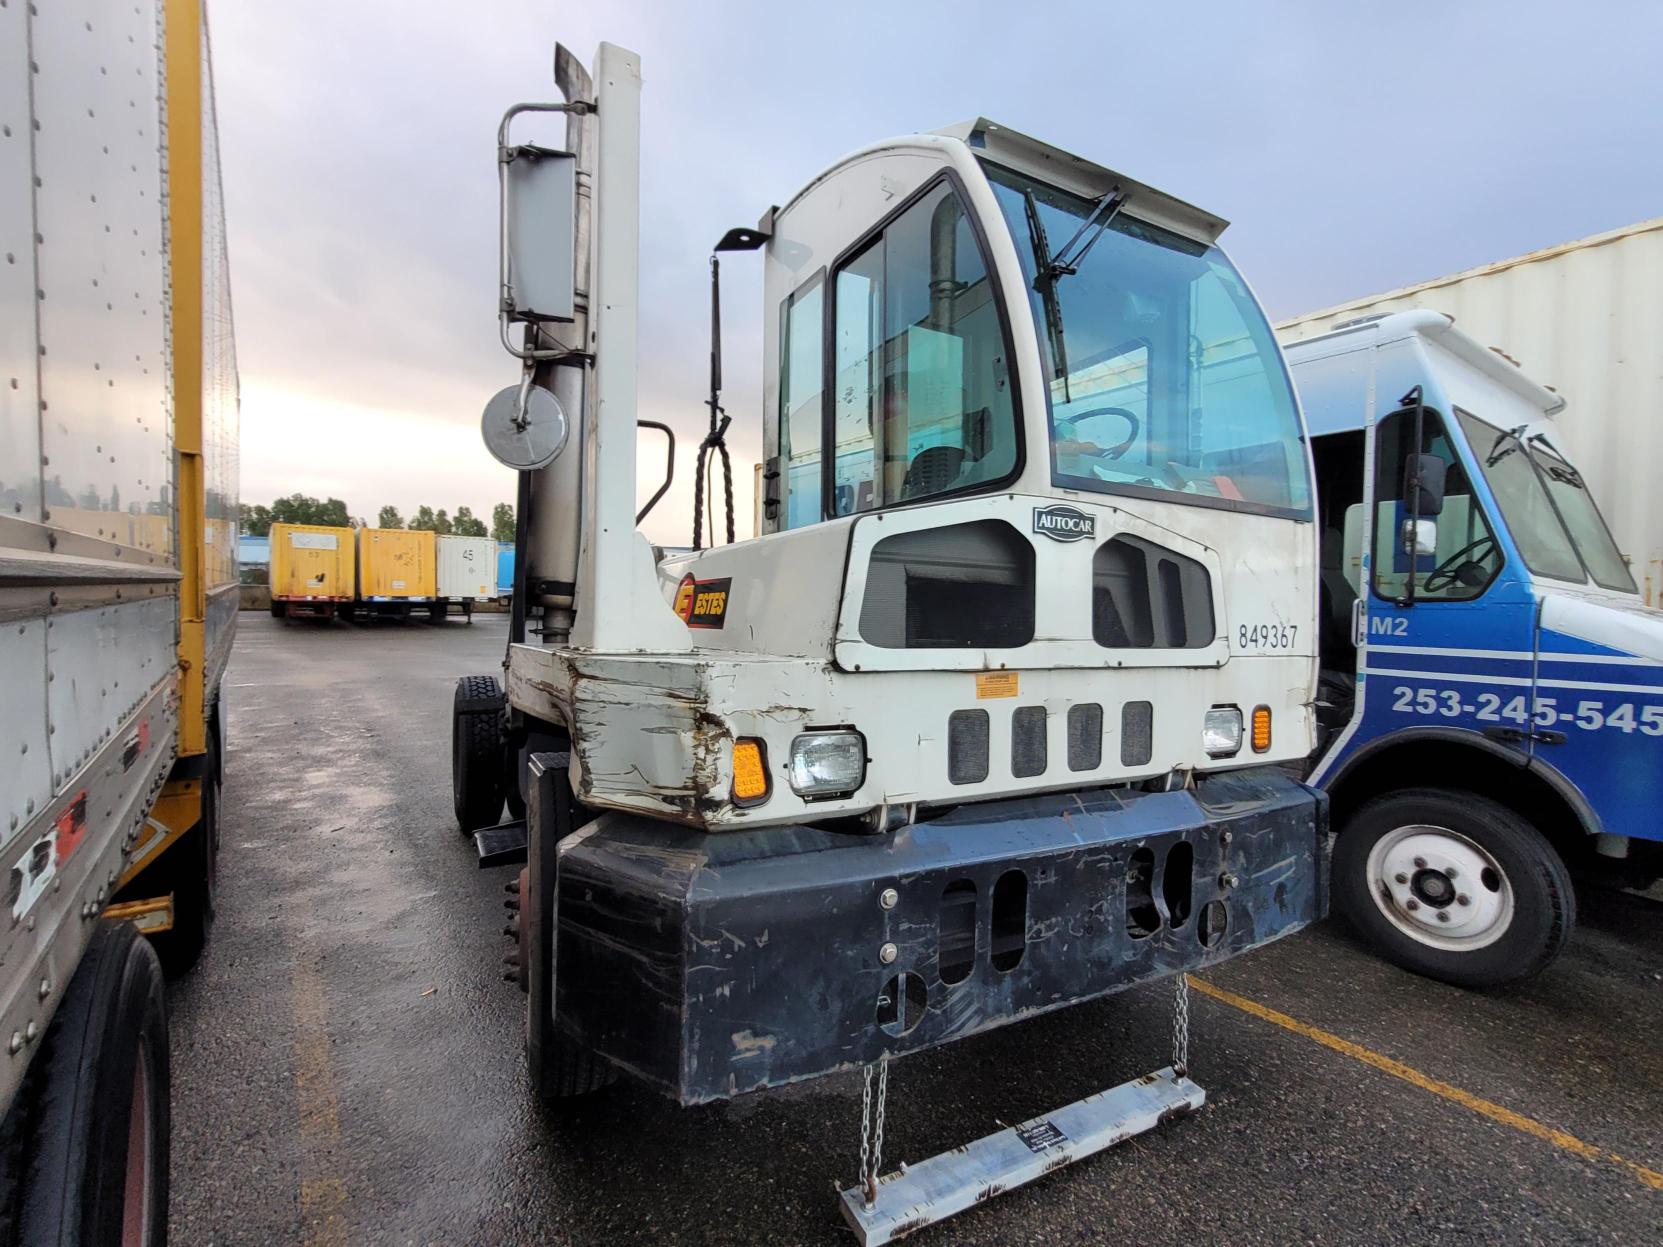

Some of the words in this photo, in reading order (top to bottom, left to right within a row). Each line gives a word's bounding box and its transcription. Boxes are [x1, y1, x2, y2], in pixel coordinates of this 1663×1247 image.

[1038, 513, 1093, 533] AUTOCAR
[693, 591, 726, 615] ESTES
[1239, 623, 1298, 649] 849367
[1371, 616, 1409, 637] M2
